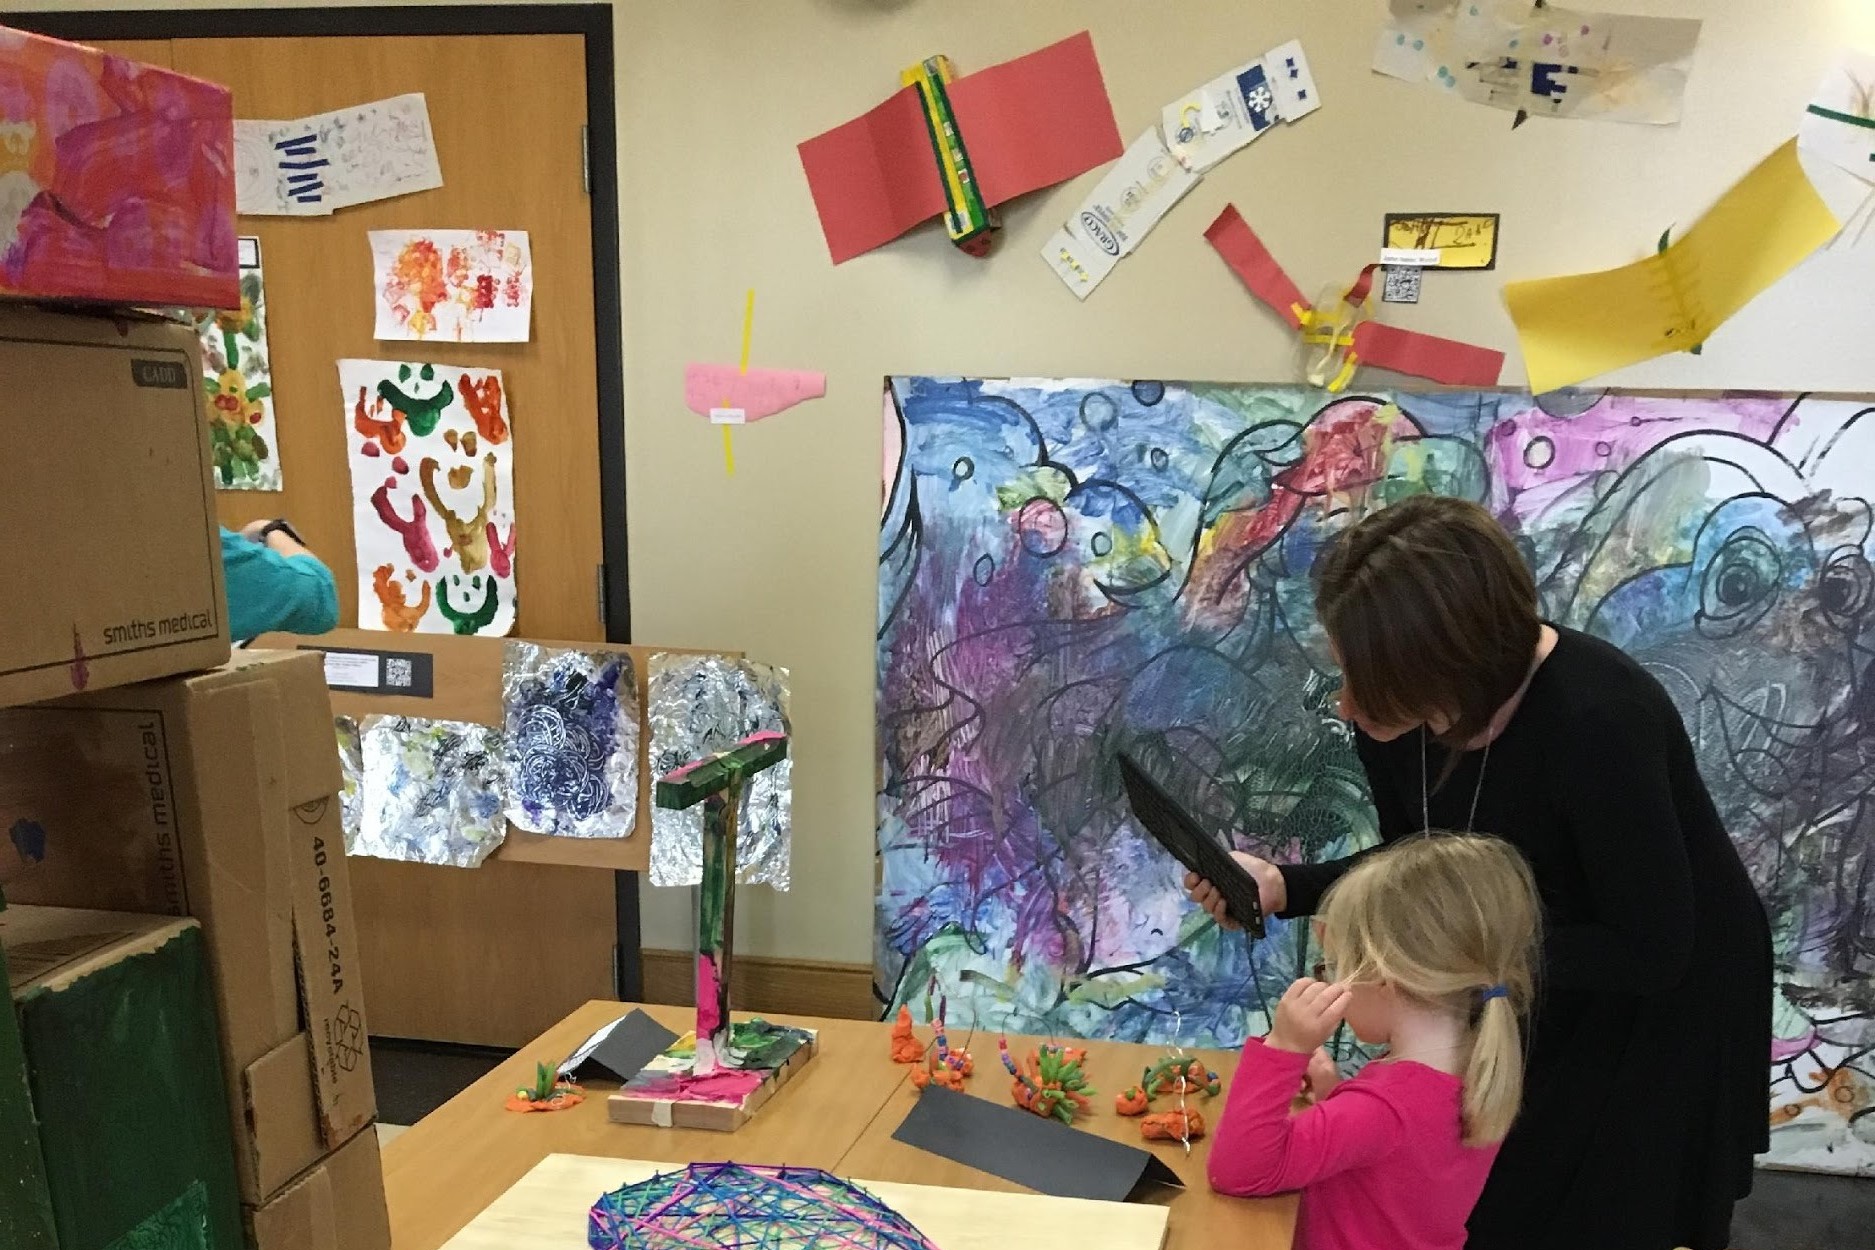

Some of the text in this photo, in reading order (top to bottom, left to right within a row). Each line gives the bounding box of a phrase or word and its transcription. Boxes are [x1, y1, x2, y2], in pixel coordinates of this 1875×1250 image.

[103, 608, 213, 645] smiths medical
[138, 721, 169, 826] medical
[313, 835, 344, 996] 40-6684-24A
